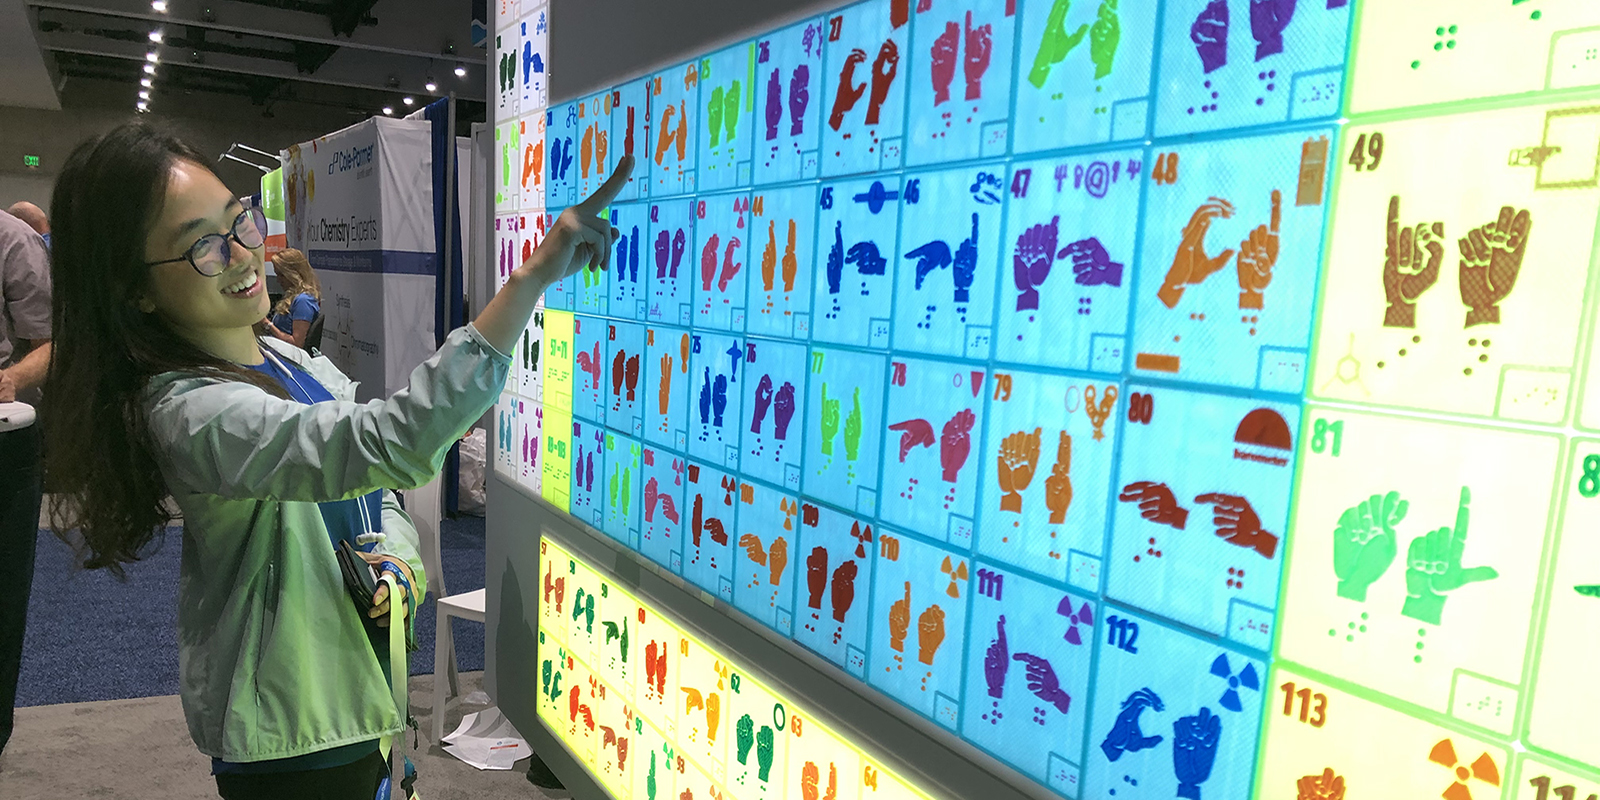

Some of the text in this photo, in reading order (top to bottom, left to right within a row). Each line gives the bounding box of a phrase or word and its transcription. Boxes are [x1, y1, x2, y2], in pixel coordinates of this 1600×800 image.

[701, 59, 710, 80] 25
[24, 155, 39, 166] EXIT
[1349, 132, 1384, 172] 49
[1152, 152, 1179, 185] 48
[904, 178, 920, 204] 46
[1010, 168, 1031, 198] 47
[752, 196, 764, 217] 44
[820, 187, 833, 210] 45
[320, 217, 350, 248] Chemistry
[351, 215, 377, 246] Experts
[746, 343, 756, 363] 76
[812, 352, 824, 374] 77
[891, 362, 907, 387] 78
[993, 373, 1012, 402] 79
[1128, 392, 1154, 425] 80
[1311, 418, 1344, 457] 81
[879, 534, 900, 562] 110
[977, 568, 1003, 602] 111
[1106, 615, 1139, 654] 112
[731, 673, 740, 694] 62
[1280, 681, 1328, 728] 113
[791, 715, 802, 737] 63
[864, 766, 877, 791] 64
